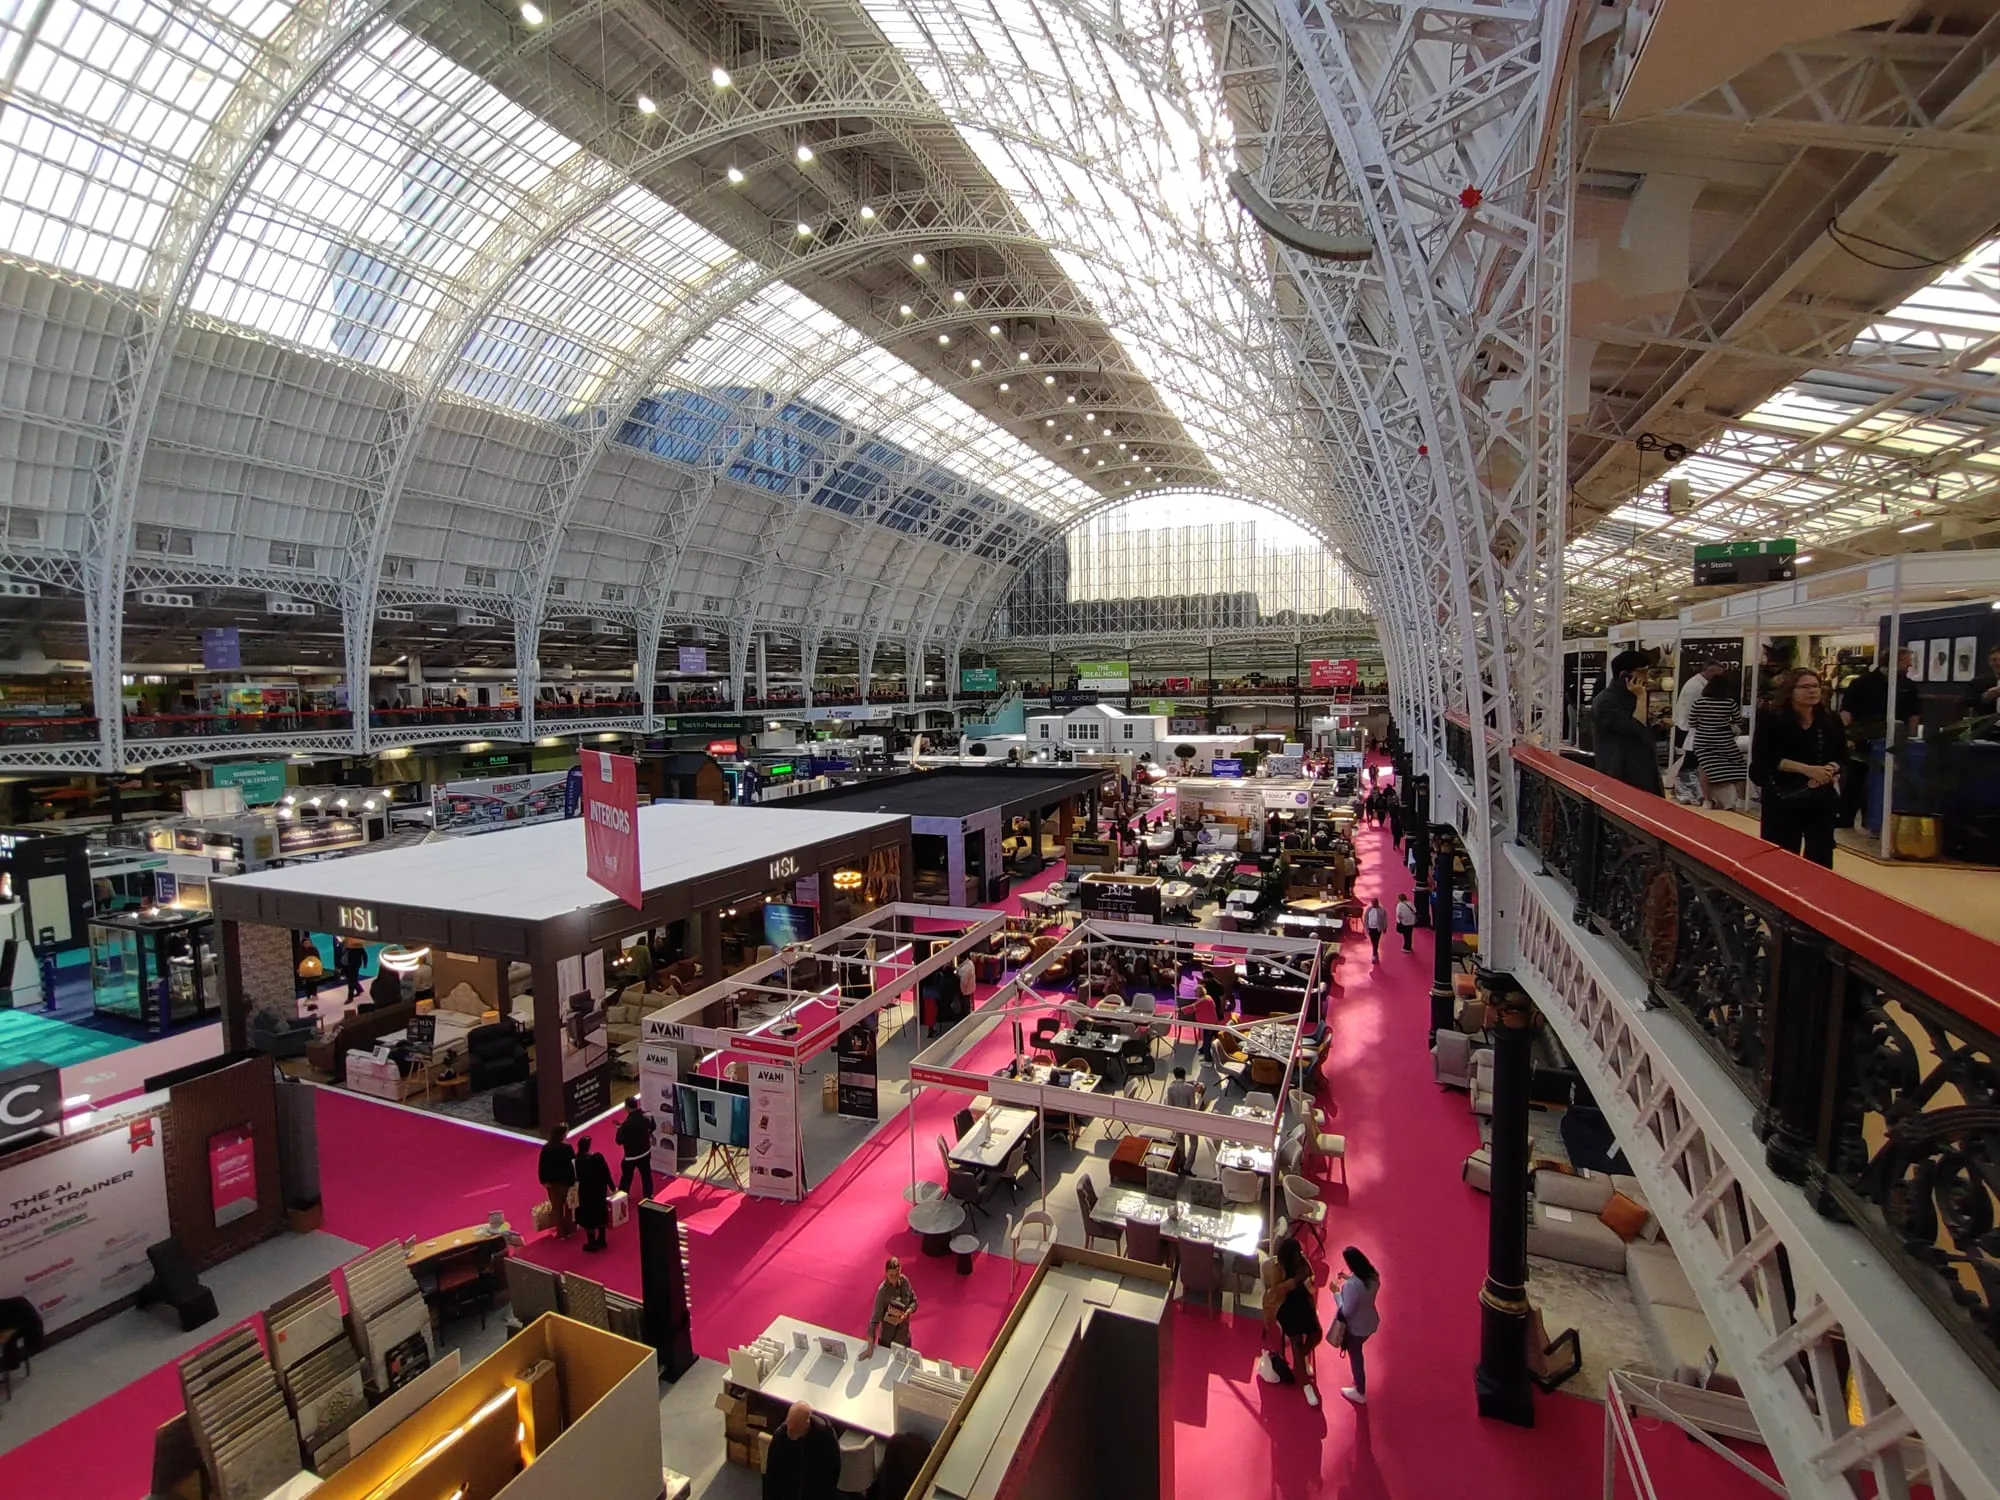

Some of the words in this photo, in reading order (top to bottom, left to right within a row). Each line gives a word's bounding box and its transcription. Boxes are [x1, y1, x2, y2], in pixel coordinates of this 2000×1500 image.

[590, 800, 630, 835] INTERIORS
[770, 856, 800, 879] HSL
[339, 906, 379, 932] HSL
[650, 1022, 684, 1040] AVANI
[646, 1053, 668, 1065] AVANI
[758, 1071, 784, 1083] AVANI
[10, 1189, 51, 1211] THE
[54, 1181, 73, 1195] AI
[55, 1170, 134, 1206] TRAINER
